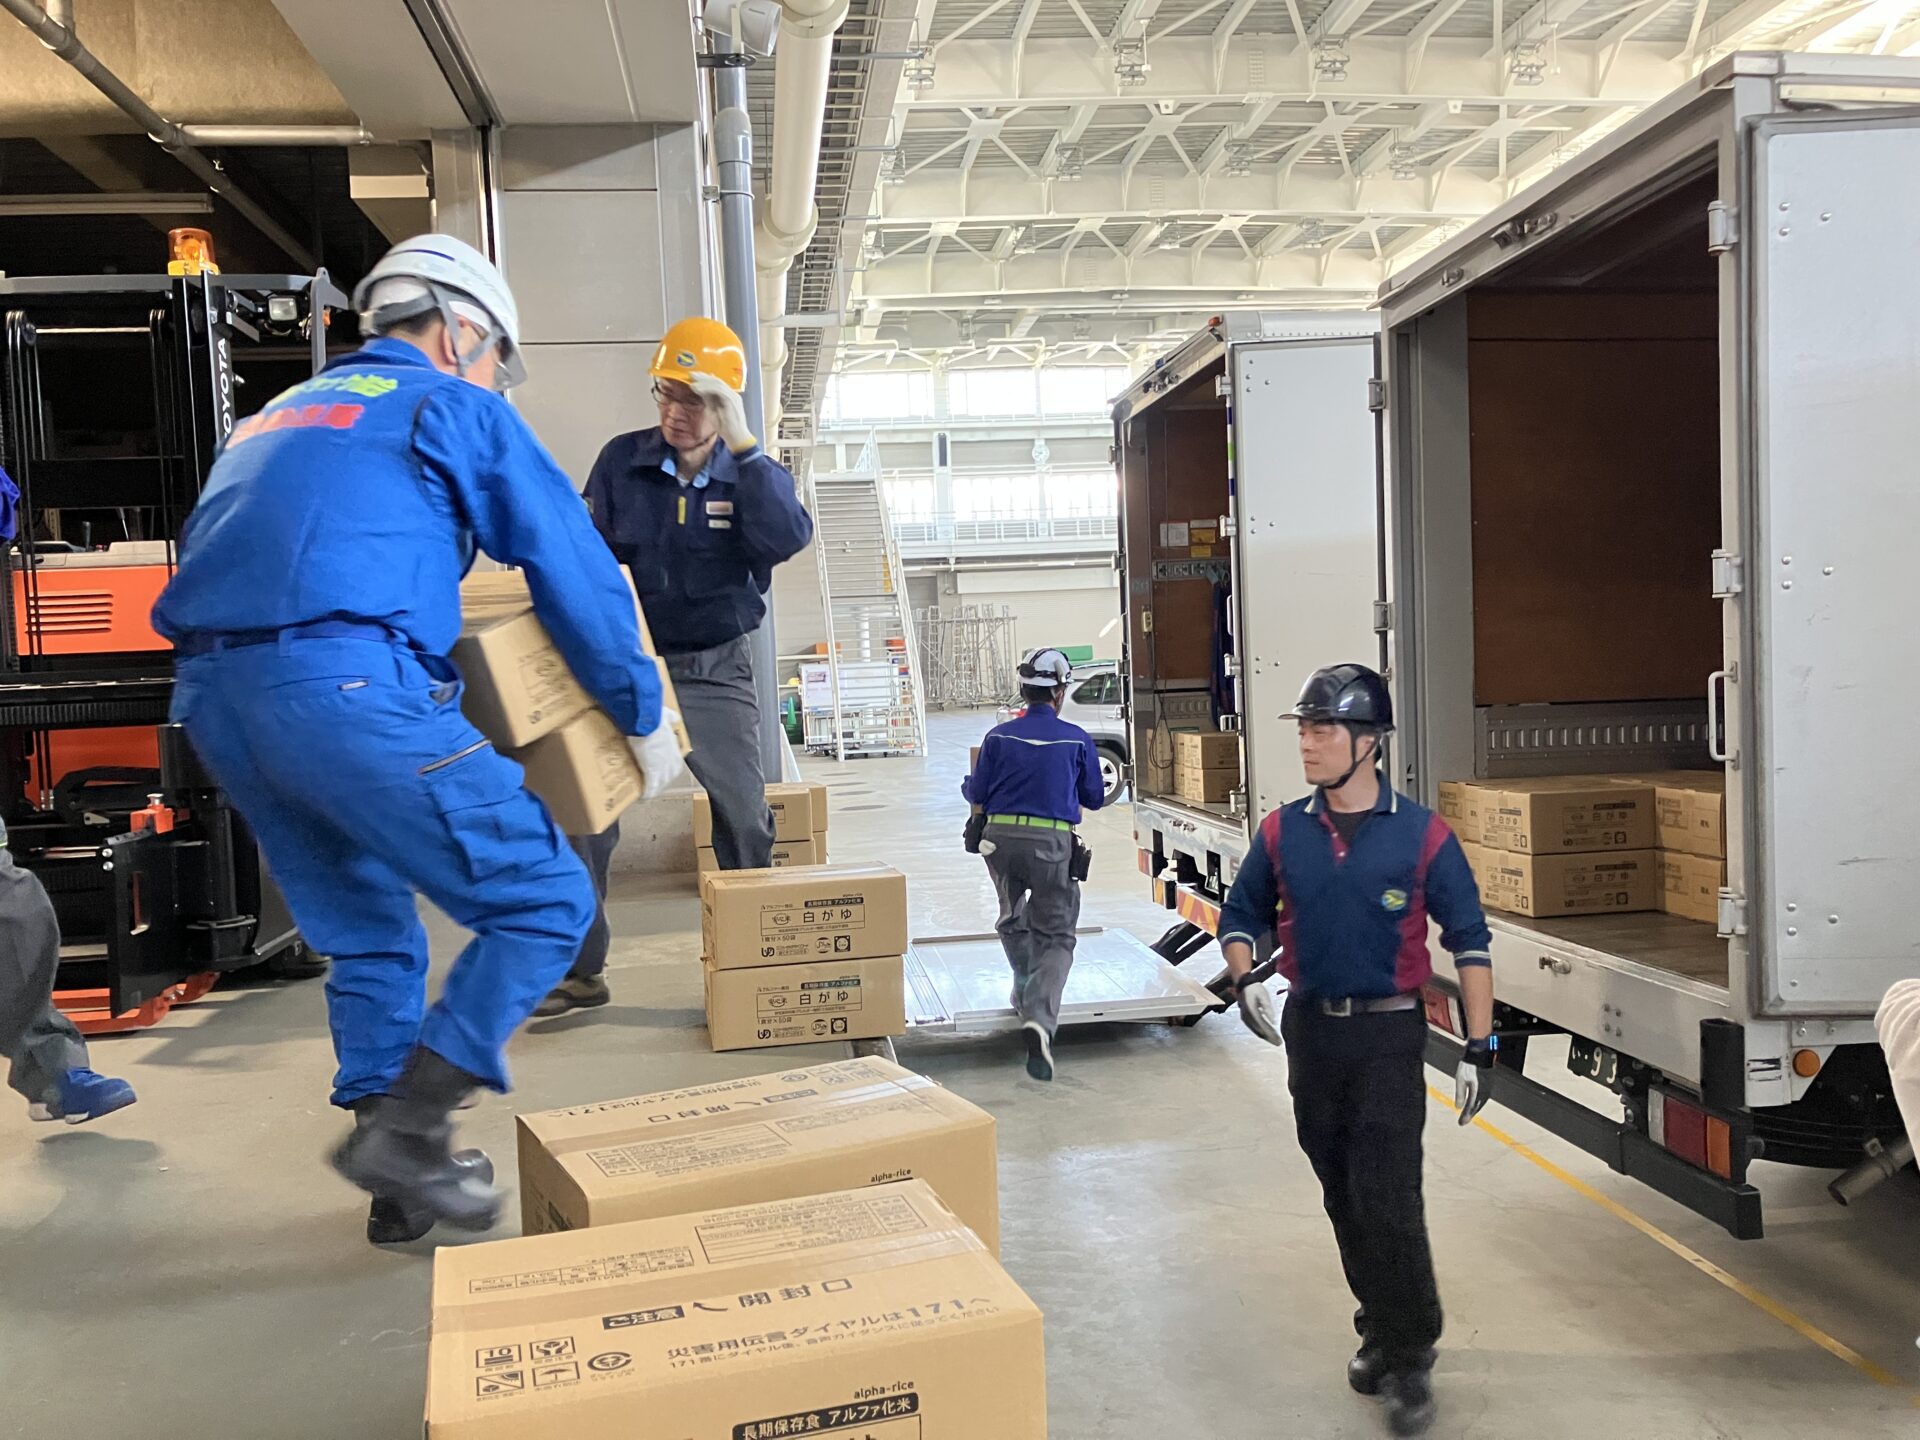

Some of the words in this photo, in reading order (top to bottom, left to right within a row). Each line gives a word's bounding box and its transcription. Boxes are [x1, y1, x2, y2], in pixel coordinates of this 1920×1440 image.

[217, 338, 232, 438] OYOTA
[803, 909, 852, 924] 白がゆ
[799, 990, 849, 1006] 白がゆ
[870, 1168, 912, 1183] alpha-rice
[608, 1307, 682, 1328] ご注意
[738, 1277, 853, 1308] 開封口
[853, 1379, 915, 1400] alpha-rice
[742, 1413, 821, 1440] 長期保存食
[827, 1397, 912, 1426] アルファ化米
